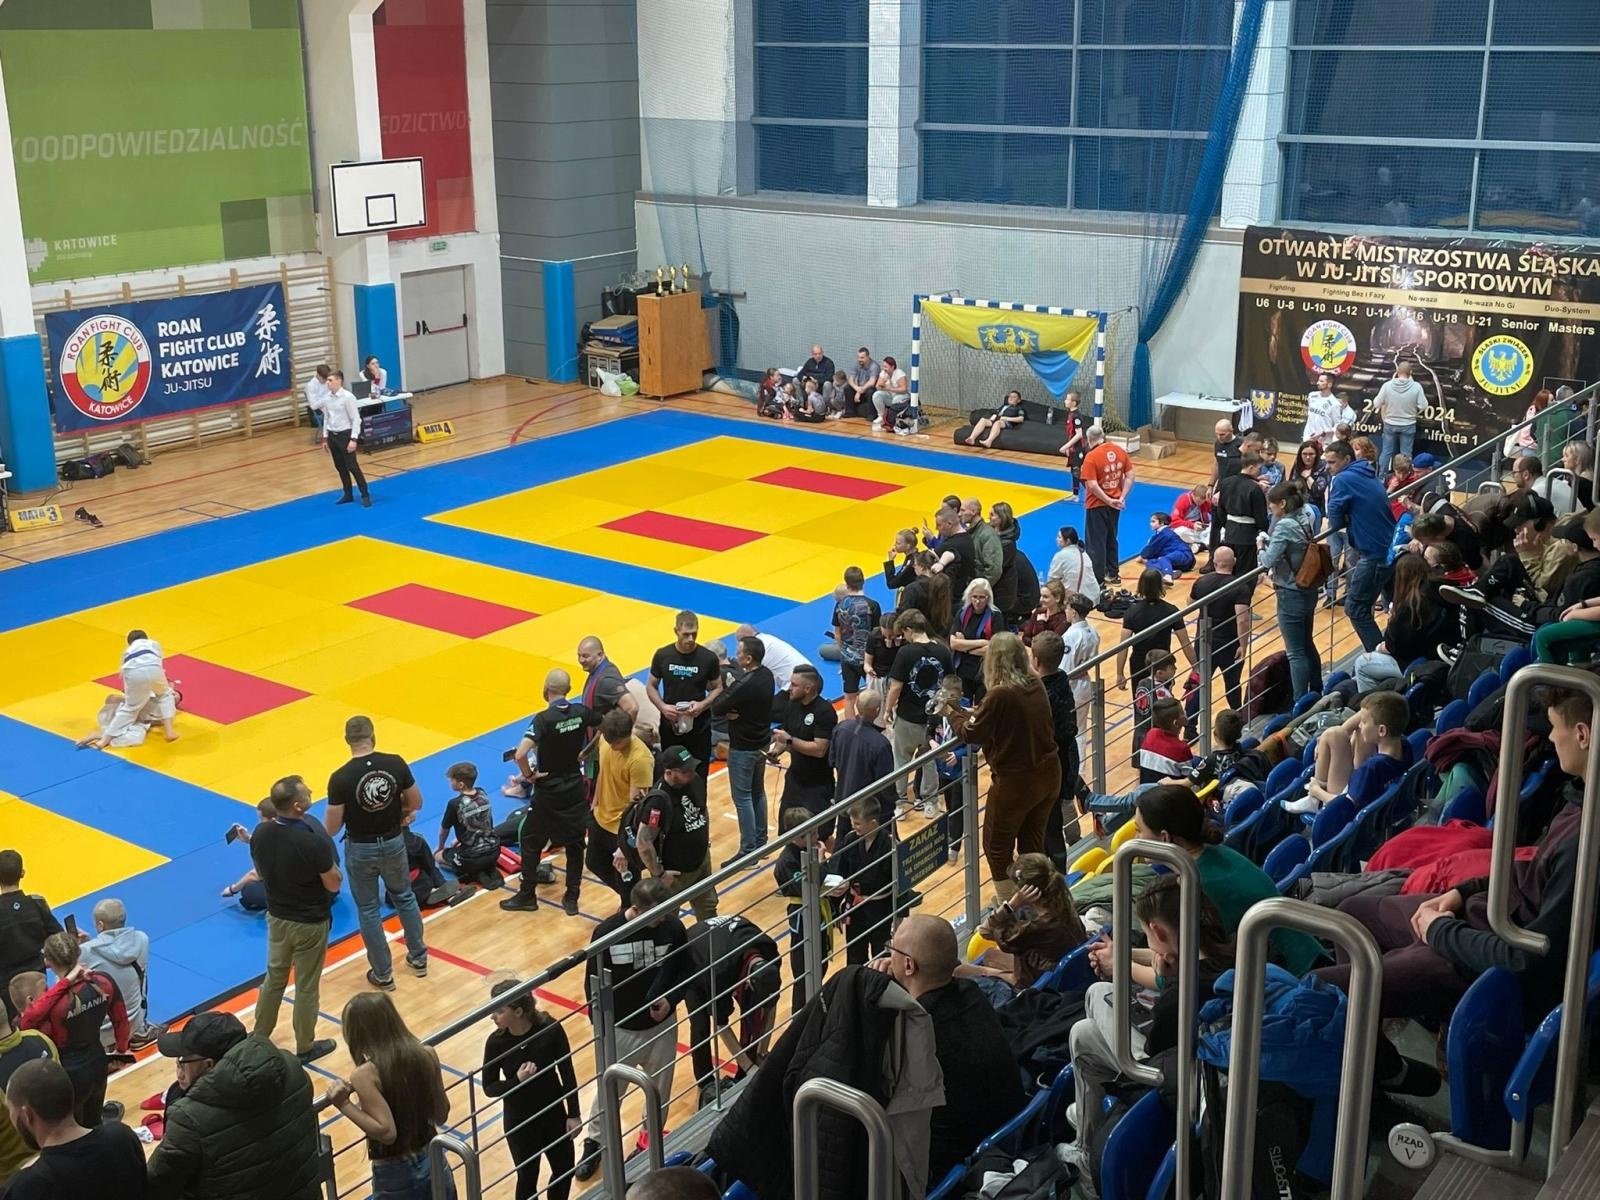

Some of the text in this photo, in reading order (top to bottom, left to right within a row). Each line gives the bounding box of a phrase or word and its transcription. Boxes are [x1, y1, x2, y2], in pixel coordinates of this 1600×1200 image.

[54, 234, 118, 250] KATOWICE
[1258, 238, 1600, 277] OTWARTE MISTRZOSTWA ŚLĄSKA
[1296, 261, 1553, 296] W JU-JITSU SPORTOWYM
[1269, 283, 1296, 292] Fighting
[1322, 287, 1350, 298] Fighting
[1256, 298, 1270, 308] U6
[1277, 300, 1295, 310] U-8
[1303, 302, 1326, 312] U-10
[1334, 305, 1358, 316] U-12
[1366, 307, 1392, 318] U-14
[1433, 312, 1458, 324] U-18
[1467, 315, 1492, 327] U-21
[1501, 319, 1540, 331] Senior
[1548, 322, 1596, 335] Masters
[1544, 305, 1591, 315] Duo-System
[157, 317, 202, 337] ROAN
[67, 319, 145, 361] ROAN FIGHT CLUB
[159, 331, 247, 358] FIGHT CLUB
[161, 353, 240, 378] KATOWICE
[163, 378, 213, 395] JU-JITSU
[88, 395, 134, 415] KATOWICE
[424, 422, 452, 435] MATA 4
[1471, 435, 1479, 446] 1
[47, 506, 58, 522] 3
[668, 663, 699, 674] GROUND
[909, 823, 939, 851] ZAKAZ
[1404, 1147, 1416, 1160] V
